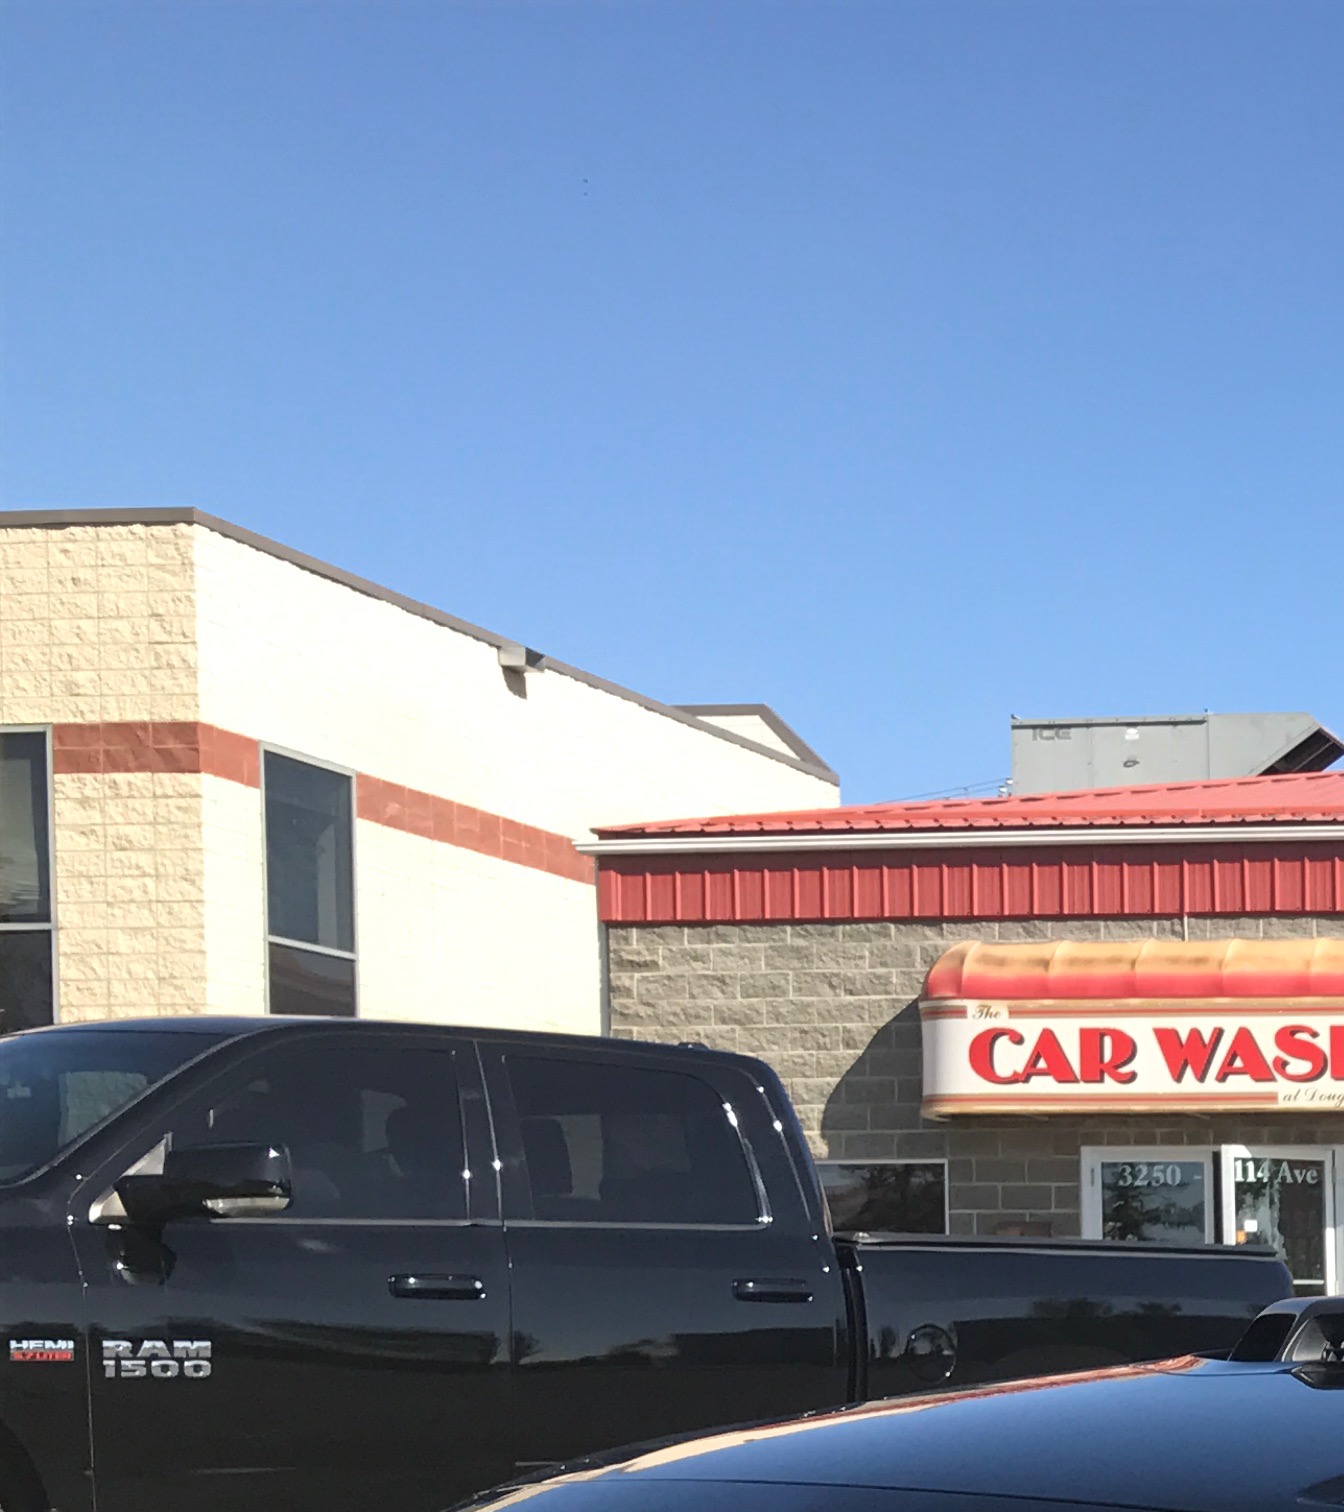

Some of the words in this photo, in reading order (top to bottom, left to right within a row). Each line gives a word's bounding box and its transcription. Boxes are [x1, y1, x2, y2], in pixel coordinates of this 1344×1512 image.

[968, 1027, 1138, 1085] CAR
[1118, 1164, 1182, 1188] 3250
[1235, 1160, 1270, 1183] 114
[1276, 1161, 1319, 1184] Ave
[9, 1340, 75, 1350] HEMI
[102, 1340, 212, 1359] RAM
[102, 1359, 212, 1378] 1500
